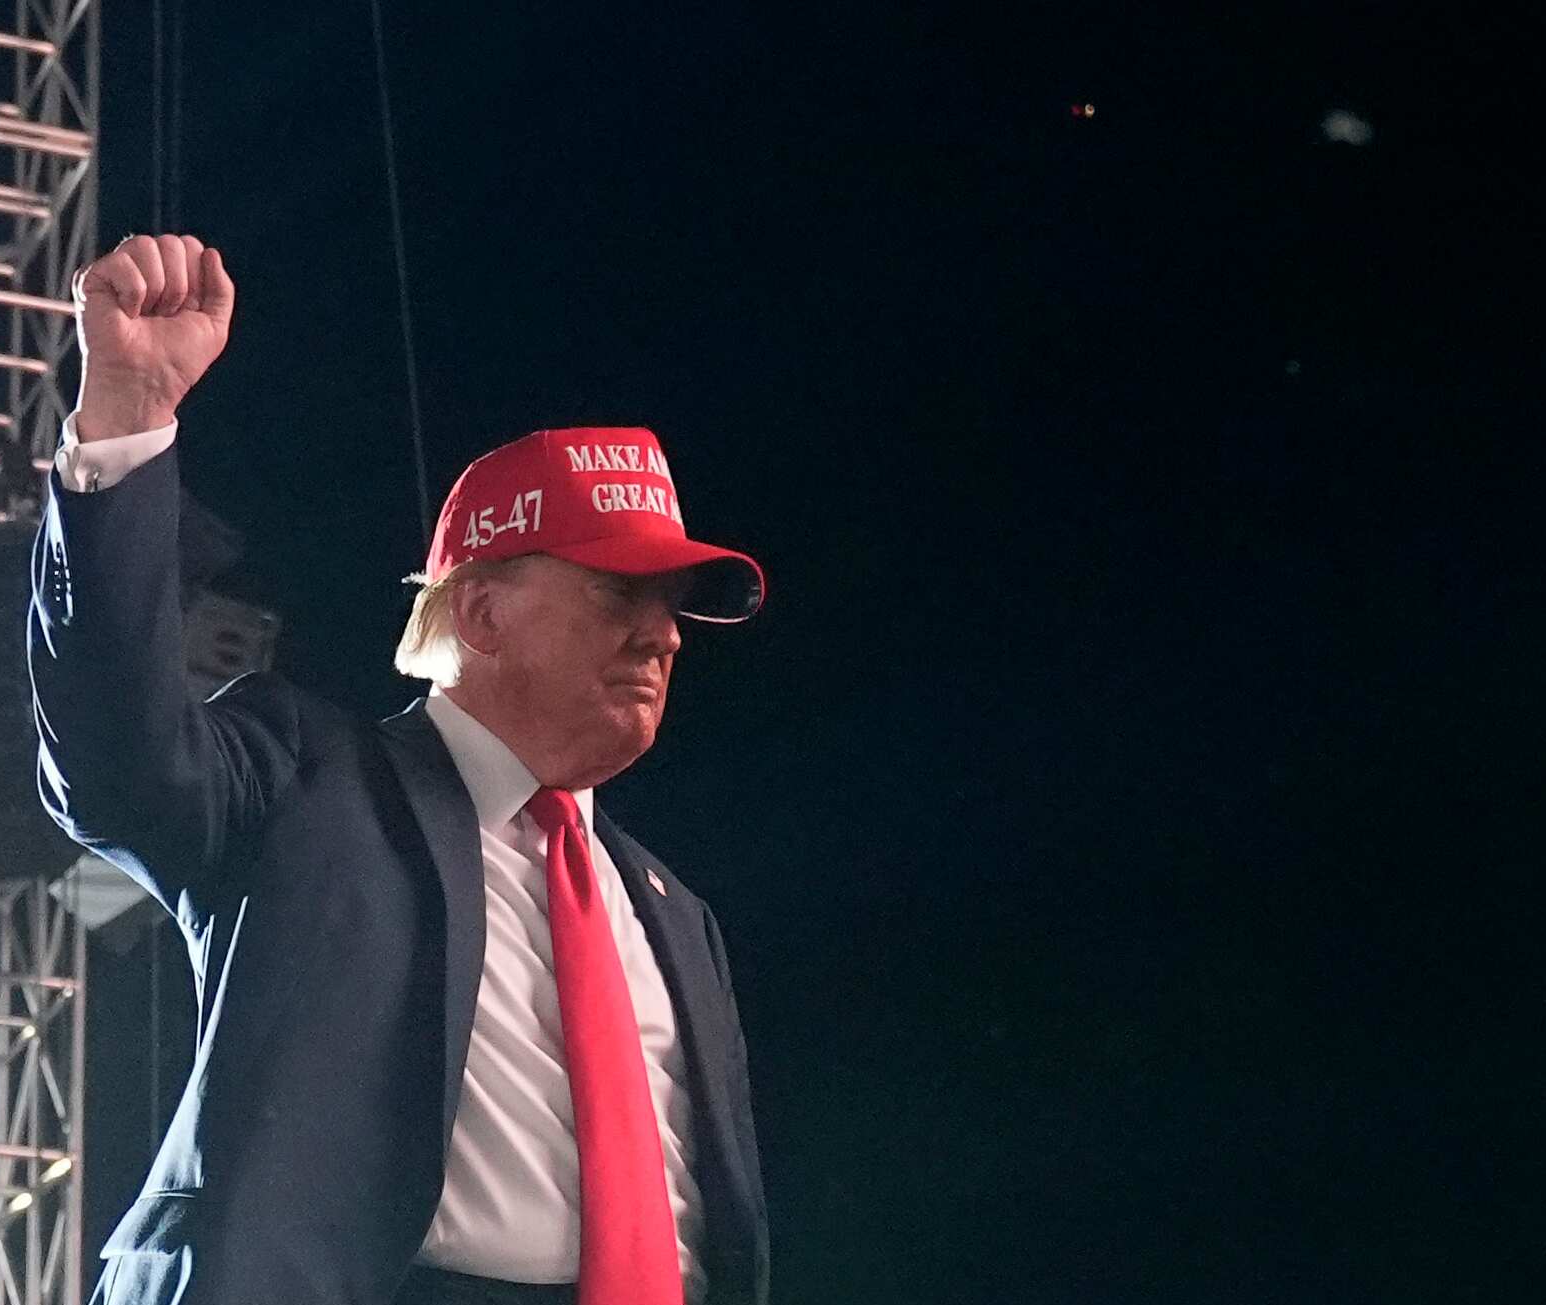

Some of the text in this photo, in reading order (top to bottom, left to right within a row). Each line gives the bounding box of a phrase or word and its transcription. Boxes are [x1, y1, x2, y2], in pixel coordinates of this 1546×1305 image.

[565, 445, 644, 472] MAKE
[591, 482, 669, 516] GREAT
[462, 488, 543, 549] 45-47
